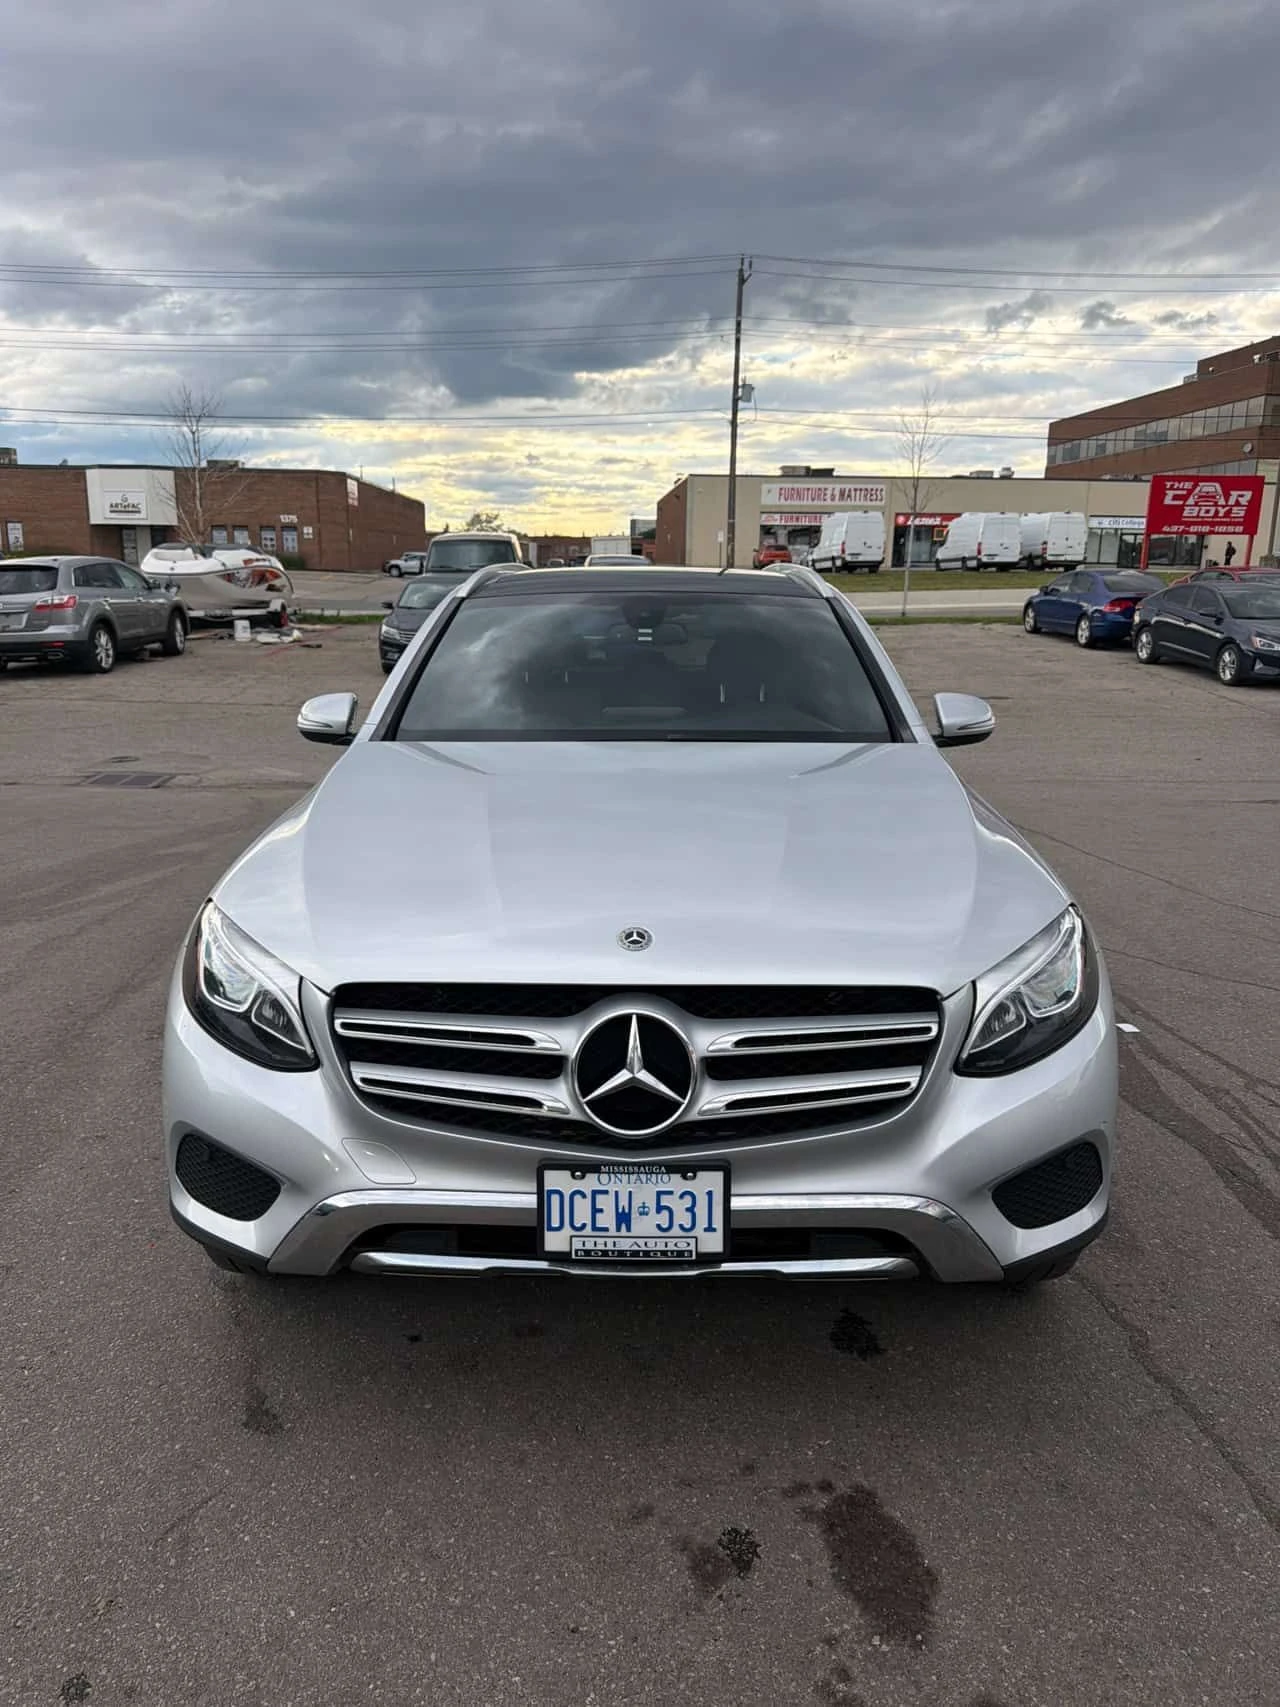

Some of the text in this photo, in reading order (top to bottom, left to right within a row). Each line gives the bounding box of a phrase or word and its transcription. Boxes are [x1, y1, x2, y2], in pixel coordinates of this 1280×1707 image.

[1164, 481, 1193, 489] THE
[778, 487, 884, 502] FURNITURE & MATTRESS
[1163, 482, 1253, 505] CAR
[1182, 506, 1247, 517] BOYS
[600, 1165, 667, 1173] MISSISSAUGA
[597, 1173, 671, 1186] ONTARIO
[546, 1189, 718, 1233] DCEW 531
[577, 1250, 692, 1258] BOUTIQUE
